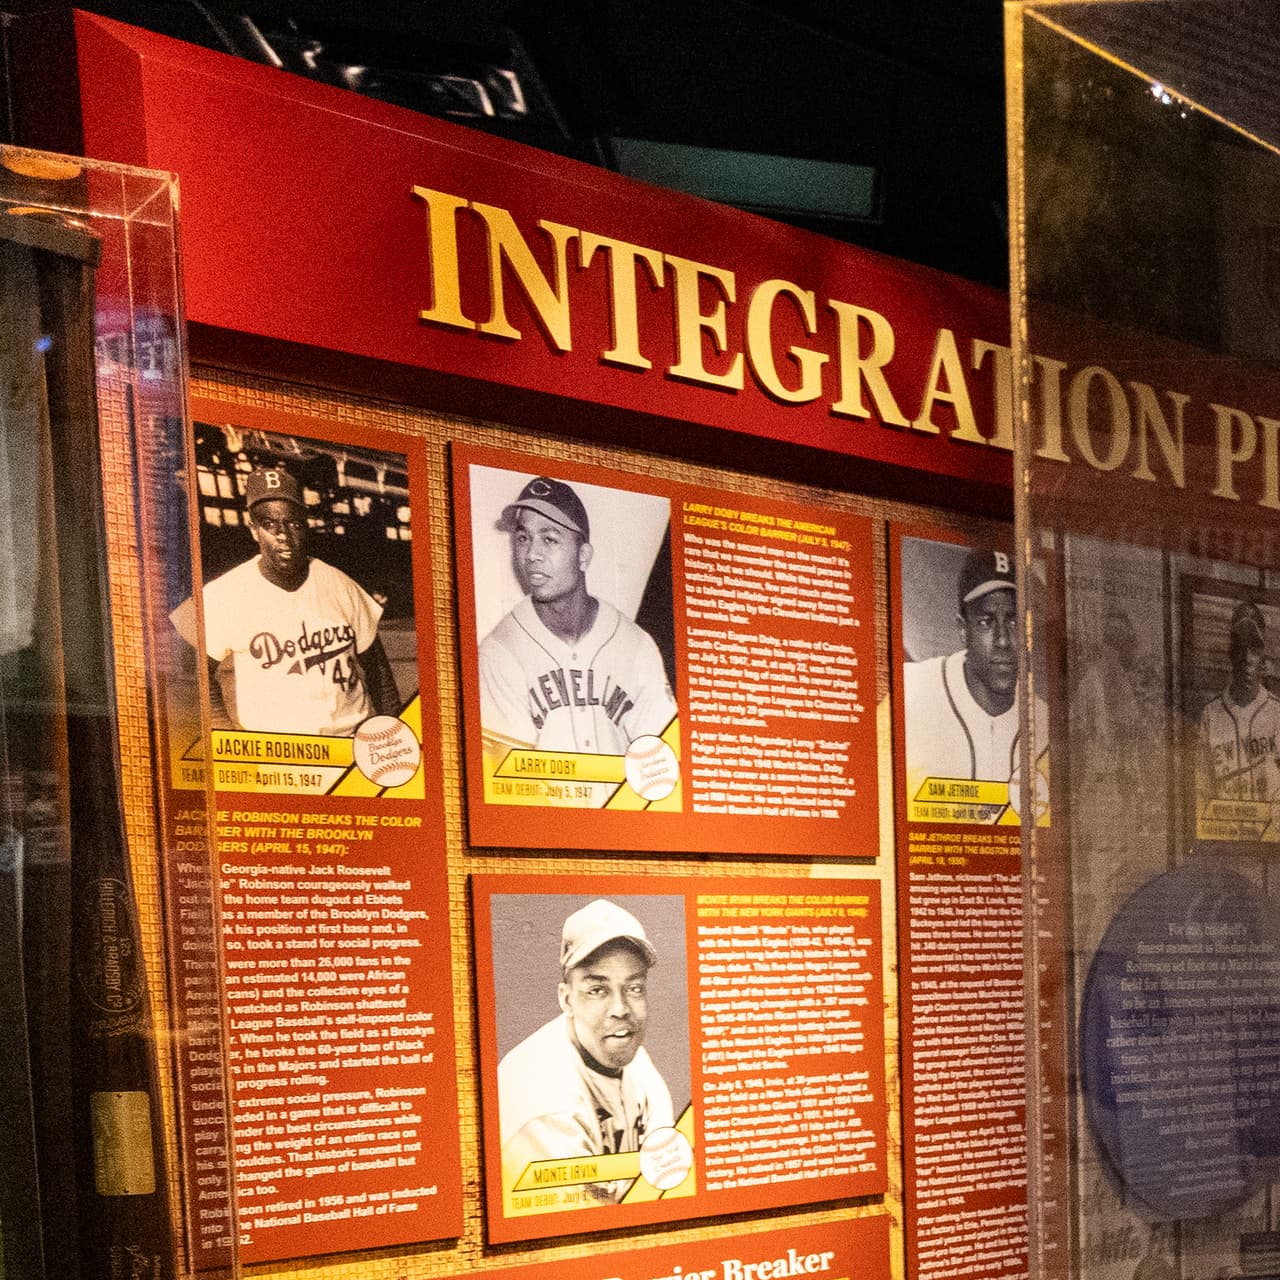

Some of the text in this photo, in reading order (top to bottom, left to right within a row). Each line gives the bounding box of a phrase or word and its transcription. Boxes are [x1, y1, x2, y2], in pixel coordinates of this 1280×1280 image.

[412, 184, 1191, 490] INTEGRATION
[994, 551, 1010, 574] B
[216, 738, 330, 760] JACKIE ROBINSON
[514, 757, 577, 775] LARRY DOBY
[219, 769, 322, 788] DEBUT: April 15, 1947
[232, 811, 422, 828] ROBINSON BREAKS THE COLOR
[244, 827, 373, 840] WITH THE BROOKLYN
[222, 864, 390, 877] Georgia-native Jack Roosevelt
[239, 879, 410, 892] Robinson courageously walked
[224, 894, 402, 907] the home team dugout Ebbets
[247, 909, 429, 922] member the Brooklyn Dodgers,
[256, 924, 341, 936] position first
[285, 939, 317, 949] stand
[320, 939, 335, 948] for
[338, 938, 370, 948] social
[290, 958, 316, 968] than
[231, 1018, 272, 1031] League
[278, 1060, 317, 1073] Majors
[375, 1086, 426, 1098] Robinson
